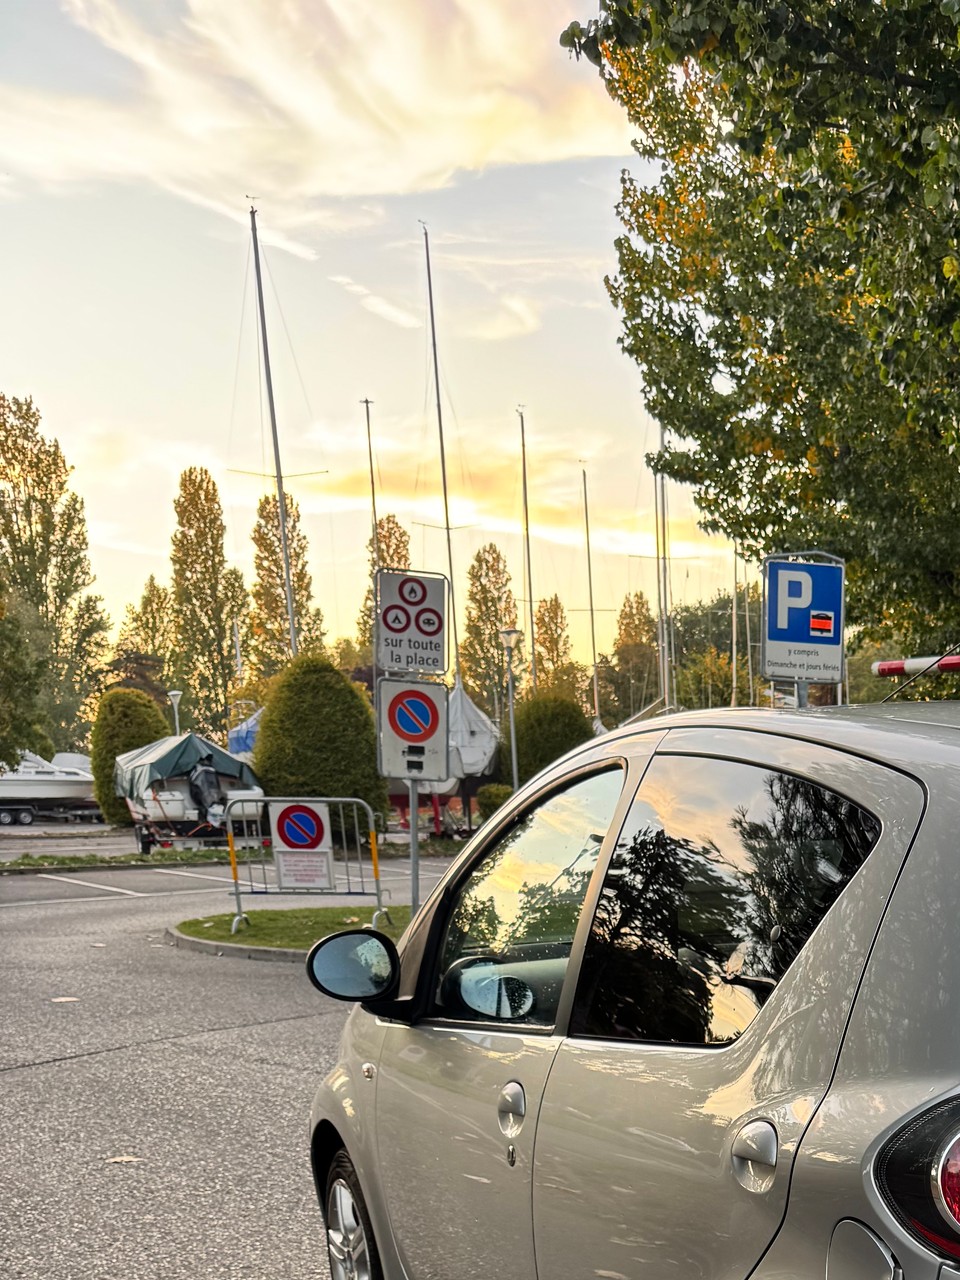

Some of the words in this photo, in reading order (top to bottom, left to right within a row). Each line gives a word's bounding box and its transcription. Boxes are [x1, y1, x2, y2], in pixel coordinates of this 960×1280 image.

[777, 569, 813, 629] P
[384, 637, 403, 648] sur
[408, 638, 441, 651] toute
[390, 650, 401, 663] la
[406, 652, 439, 667] place
[793, 649, 819, 657] compris
[767, 660, 797, 670] Dimanche
[799, 662, 805, 670] et
[806, 663, 821, 671] jours
